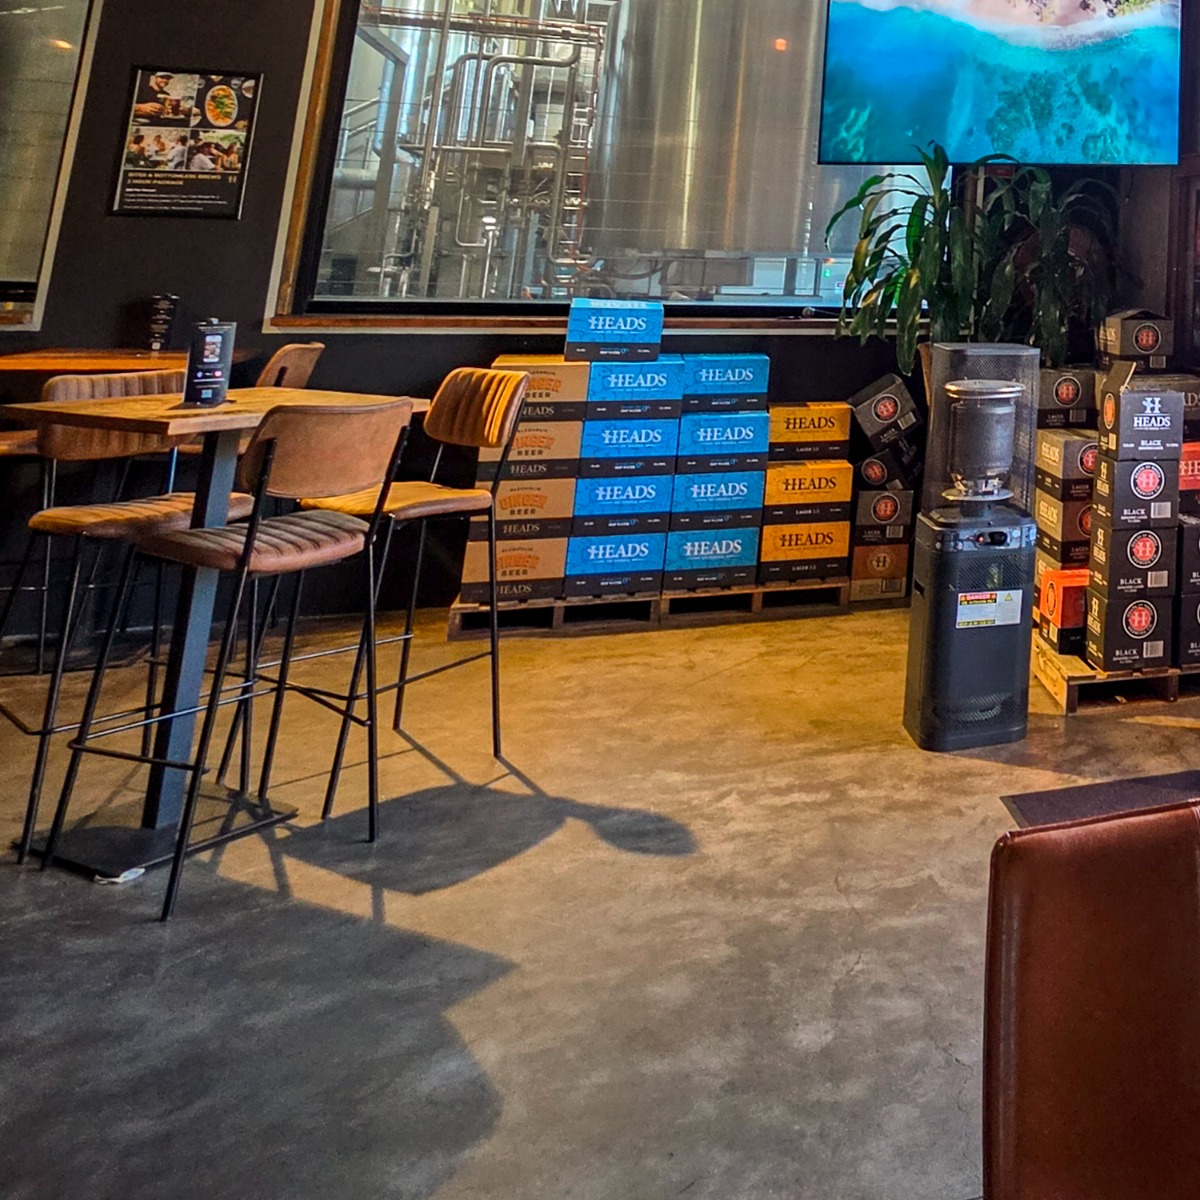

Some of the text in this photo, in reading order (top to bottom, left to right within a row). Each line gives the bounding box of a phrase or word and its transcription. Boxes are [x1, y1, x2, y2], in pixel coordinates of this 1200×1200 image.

[588, 316, 647, 331] HEADS
[608, 373, 668, 388] HEADS
[699, 367, 754, 382] HEADS
[785, 416, 836, 430] HEADS
[1133, 416, 1172, 428] HEADS
[602, 429, 662, 444] HEADS
[697, 426, 754, 441] HEADS
[510, 464, 548, 474] HEADS
[690, 482, 748, 498] HEADS
[783, 477, 837, 491] HEADS
[595, 484, 656, 501] HEADS
[510, 508, 537, 516] BEER
[503, 523, 541, 534] HEADS
[779, 532, 834, 547] HEADS
[587, 543, 649, 560] HEADS
[683, 539, 743, 556] HEADS
[501, 569, 529, 577] BEER
[1115, 649, 1138, 657] BLACK
